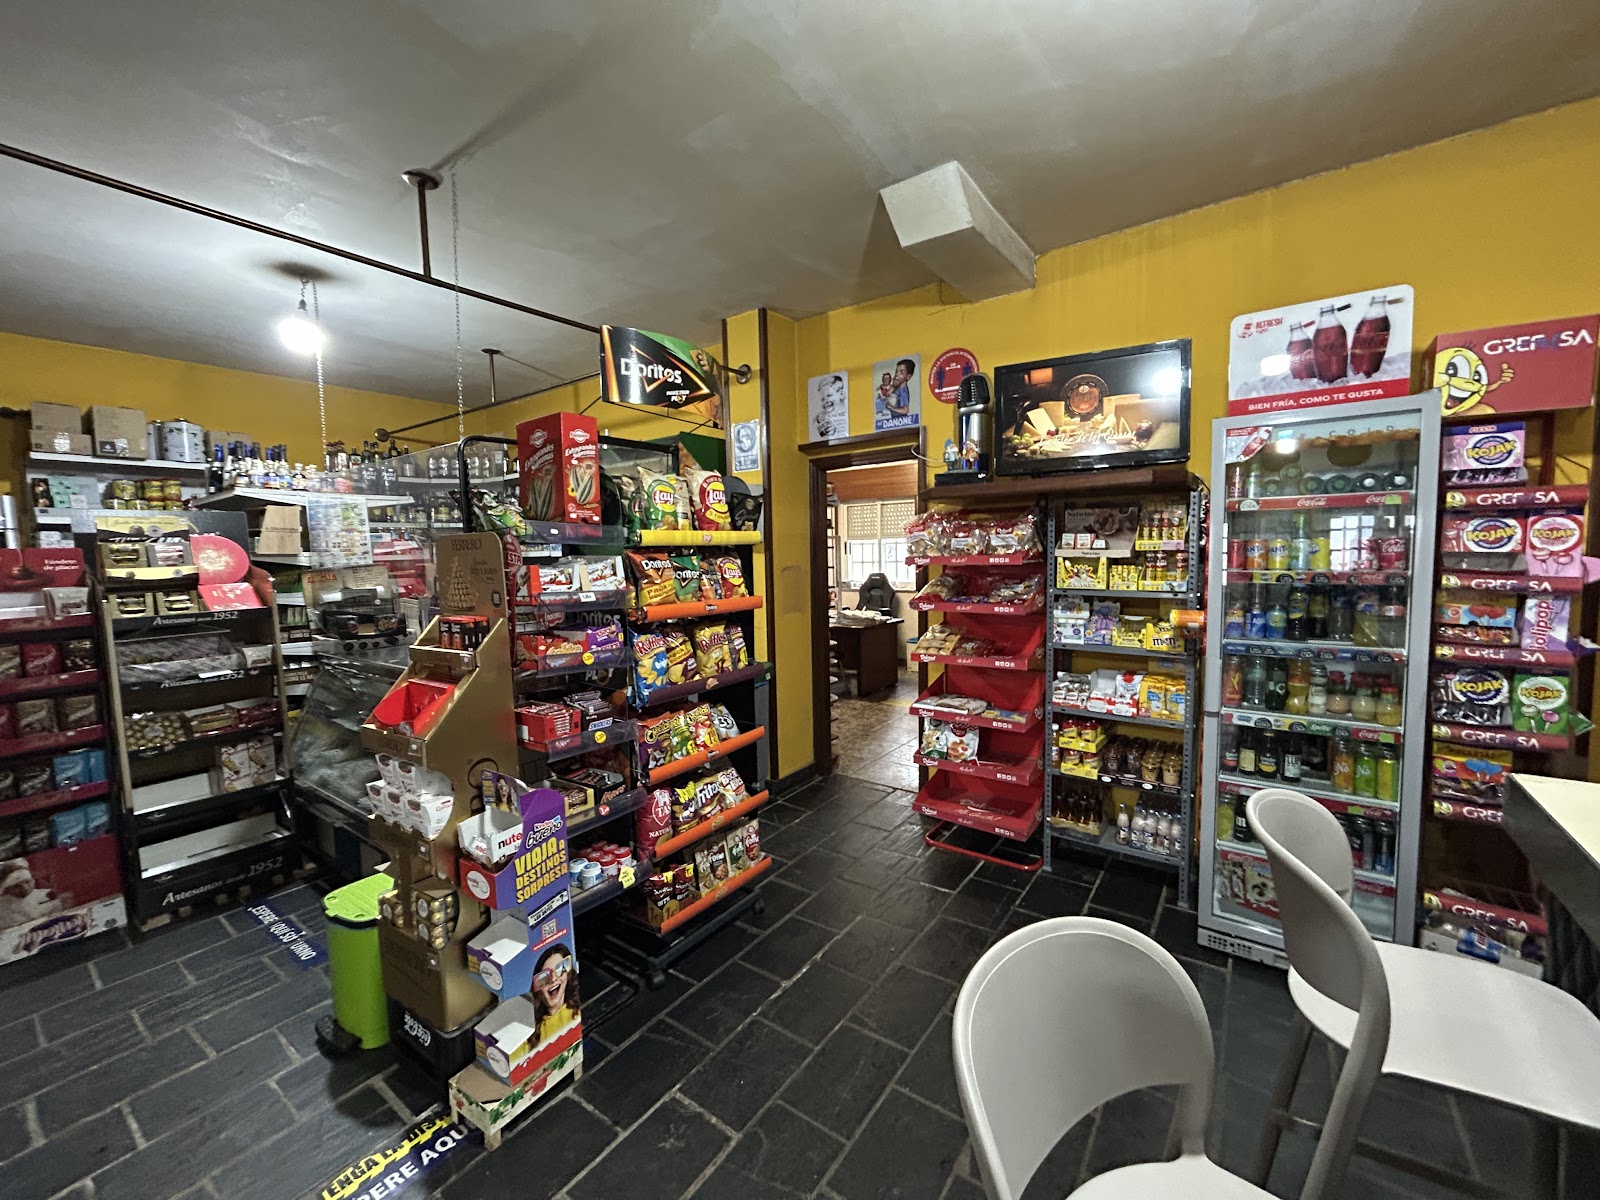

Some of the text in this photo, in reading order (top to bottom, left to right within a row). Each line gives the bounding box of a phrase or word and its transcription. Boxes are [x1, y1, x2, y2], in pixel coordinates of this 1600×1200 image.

[1255, 317, 1283, 330] REFRESH
[620, 358, 682, 384] Doritos
[1248, 388, 1384, 412] BIEN FRÍA, COMO TE GUSTA
[1053, 434, 1074, 446] Flor
[1076, 433, 1087, 443] de
[1466, 439, 1518, 459] KOJAK
[654, 490, 674, 505] Lay
[709, 490, 726, 505] Lay
[1297, 497, 1327, 507] Coca-Cola
[1476, 491, 1560, 505] GREFSA
[1465, 524, 1517, 542] KOJAK
[1532, 528, 1578, 539] KOJAK
[641, 559, 672, 571] Doritos
[675, 569, 701, 579] oritos
[647, 584, 668, 595] Pack
[1471, 578, 1552, 592] GREFSA
[213, 610, 238, 620] 1952
[578, 611, 621, 628] orito
[634, 634, 671, 656] Ruffles
[1465, 647, 1545, 663] GREFSA
[1454, 679, 1504, 693] KOJAK
[1520, 686, 1564, 699] KOJAK
[590, 718, 613, 730] SNICKERS
[1461, 729, 1540, 750] GREFSA
[696, 780, 721, 808] Frito
[1462, 806, 1505, 822] GREF
[498, 832, 523, 850] nute
[526, 820, 564, 849] bueno
[514, 836, 565, 877] VIAJA A
[515, 850, 567, 890] DESTINOS
[162, 880, 223, 906] Artesanos
[248, 856, 284, 877] 1952
[516, 862, 568, 904] SORPRESA
[1451, 904, 1530, 931] GREFSA
[352, 1161, 419, 1200] PERE
[420, 1125, 469, 1166] AQU
